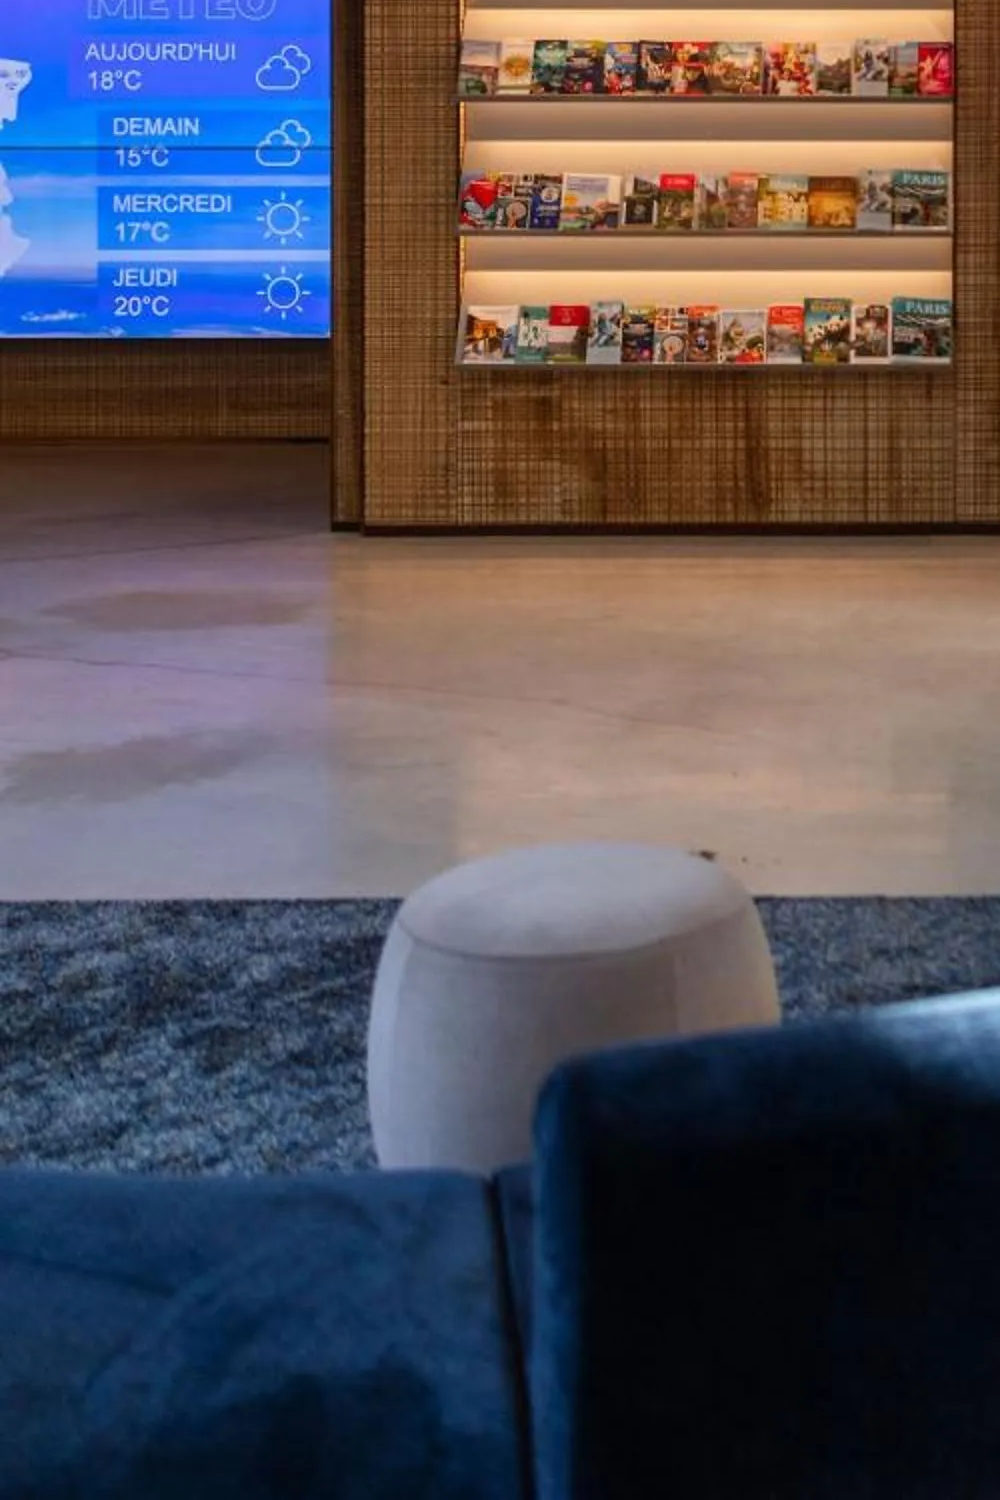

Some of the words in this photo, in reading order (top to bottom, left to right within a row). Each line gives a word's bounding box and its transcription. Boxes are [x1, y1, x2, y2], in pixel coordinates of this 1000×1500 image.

[85, 43, 237, 61] AUJOURD'HUI
[88, 71, 142, 91] 18°C
[113, 117, 200, 136] DEMAIN
[113, 194, 232, 213] MERCREDI
[115, 221, 170, 243] 17°C
[112, 268, 177, 288] JEUDI
[113, 296, 169, 317] 20°C
[905, 301, 949, 314] PARIS
